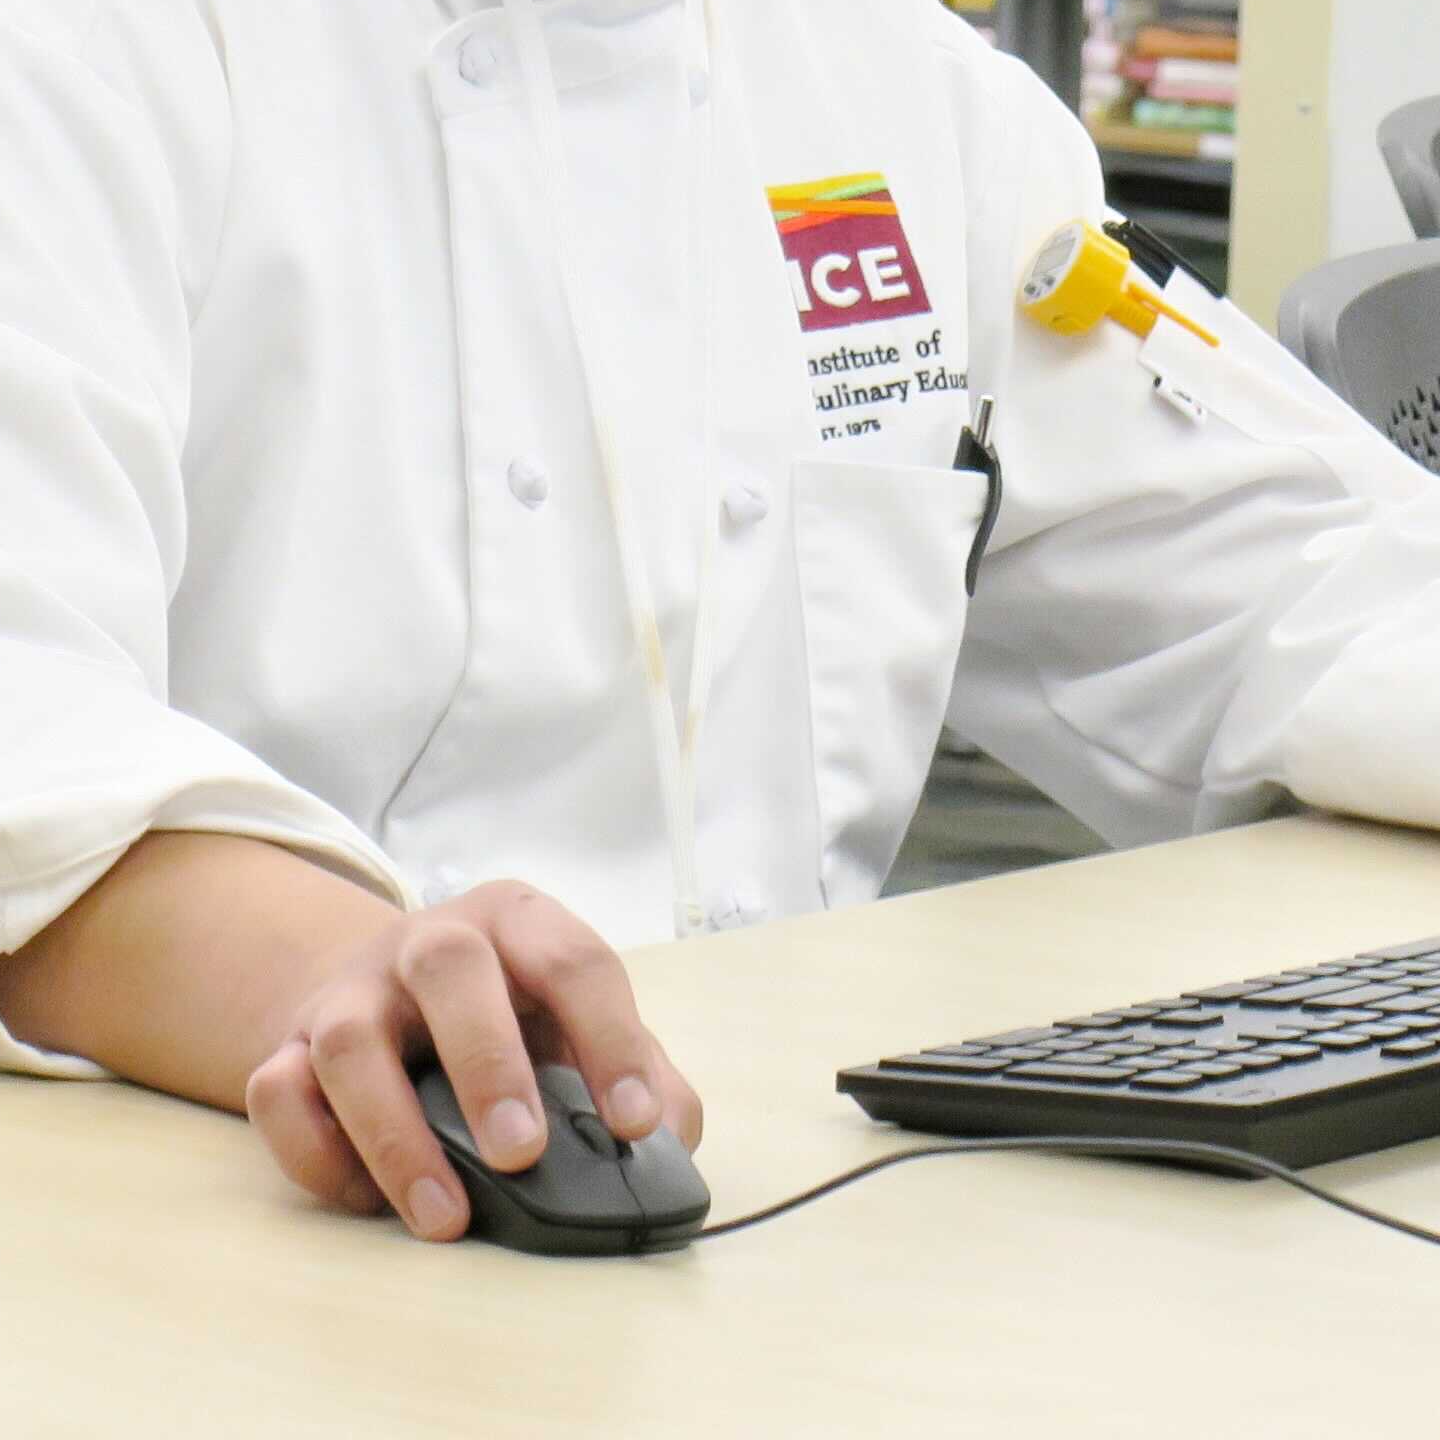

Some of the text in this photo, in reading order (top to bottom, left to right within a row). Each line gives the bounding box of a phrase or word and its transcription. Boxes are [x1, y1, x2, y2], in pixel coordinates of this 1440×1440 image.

[785, 245, 911, 311] ICE
[916, 329, 942, 358] of
[814, 379, 911, 411] ulinary
